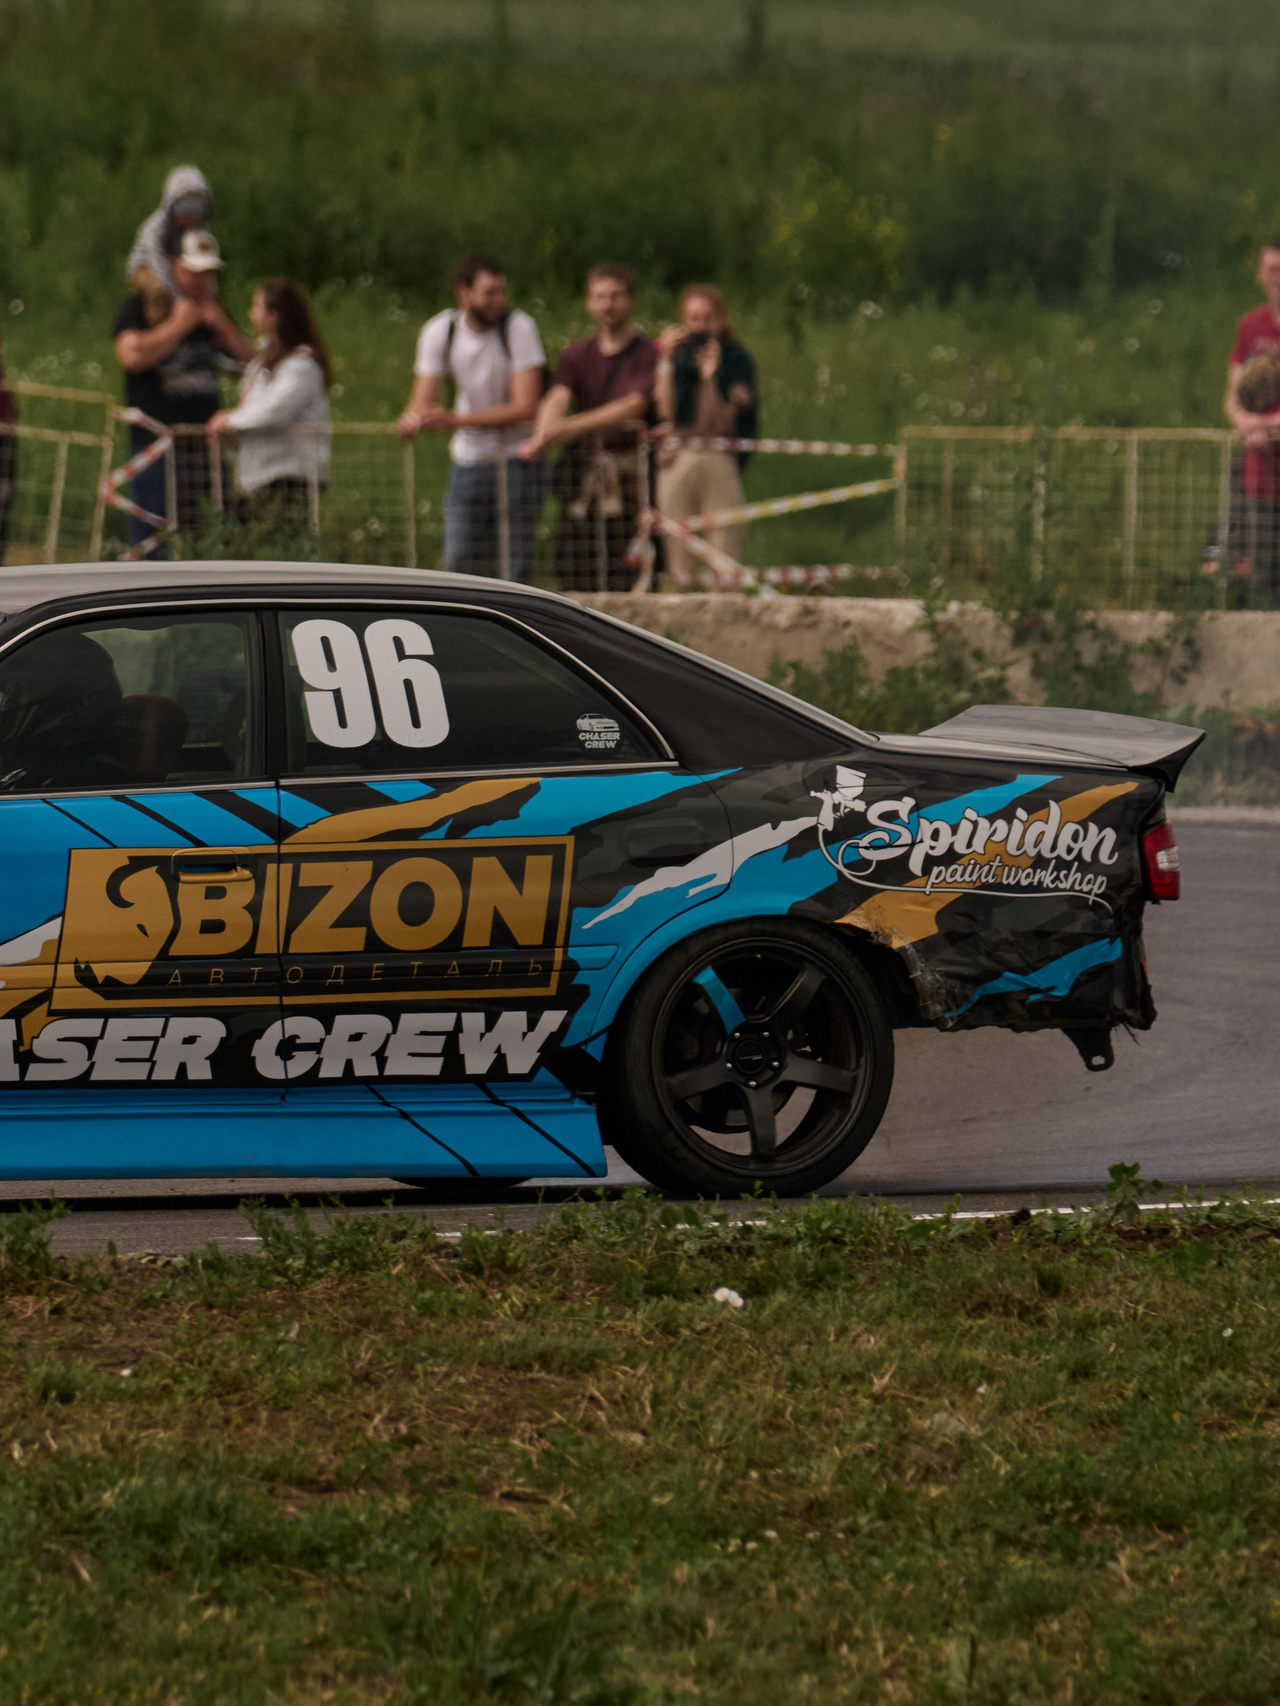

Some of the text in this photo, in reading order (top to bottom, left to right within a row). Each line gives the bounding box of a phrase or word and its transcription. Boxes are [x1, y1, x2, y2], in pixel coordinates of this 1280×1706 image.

[291, 618, 450, 748] 96
[578, 732, 620, 741] CHASER
[584, 740, 617, 749] CREW
[858, 796, 1119, 877] Spiridon
[168, 854, 554, 956] BIZON
[926, 855, 1108, 905] paint workshop
[167, 959, 543, 987] АВТОДЕТАЛЬ
[252, 1010, 568, 1080] CREW
